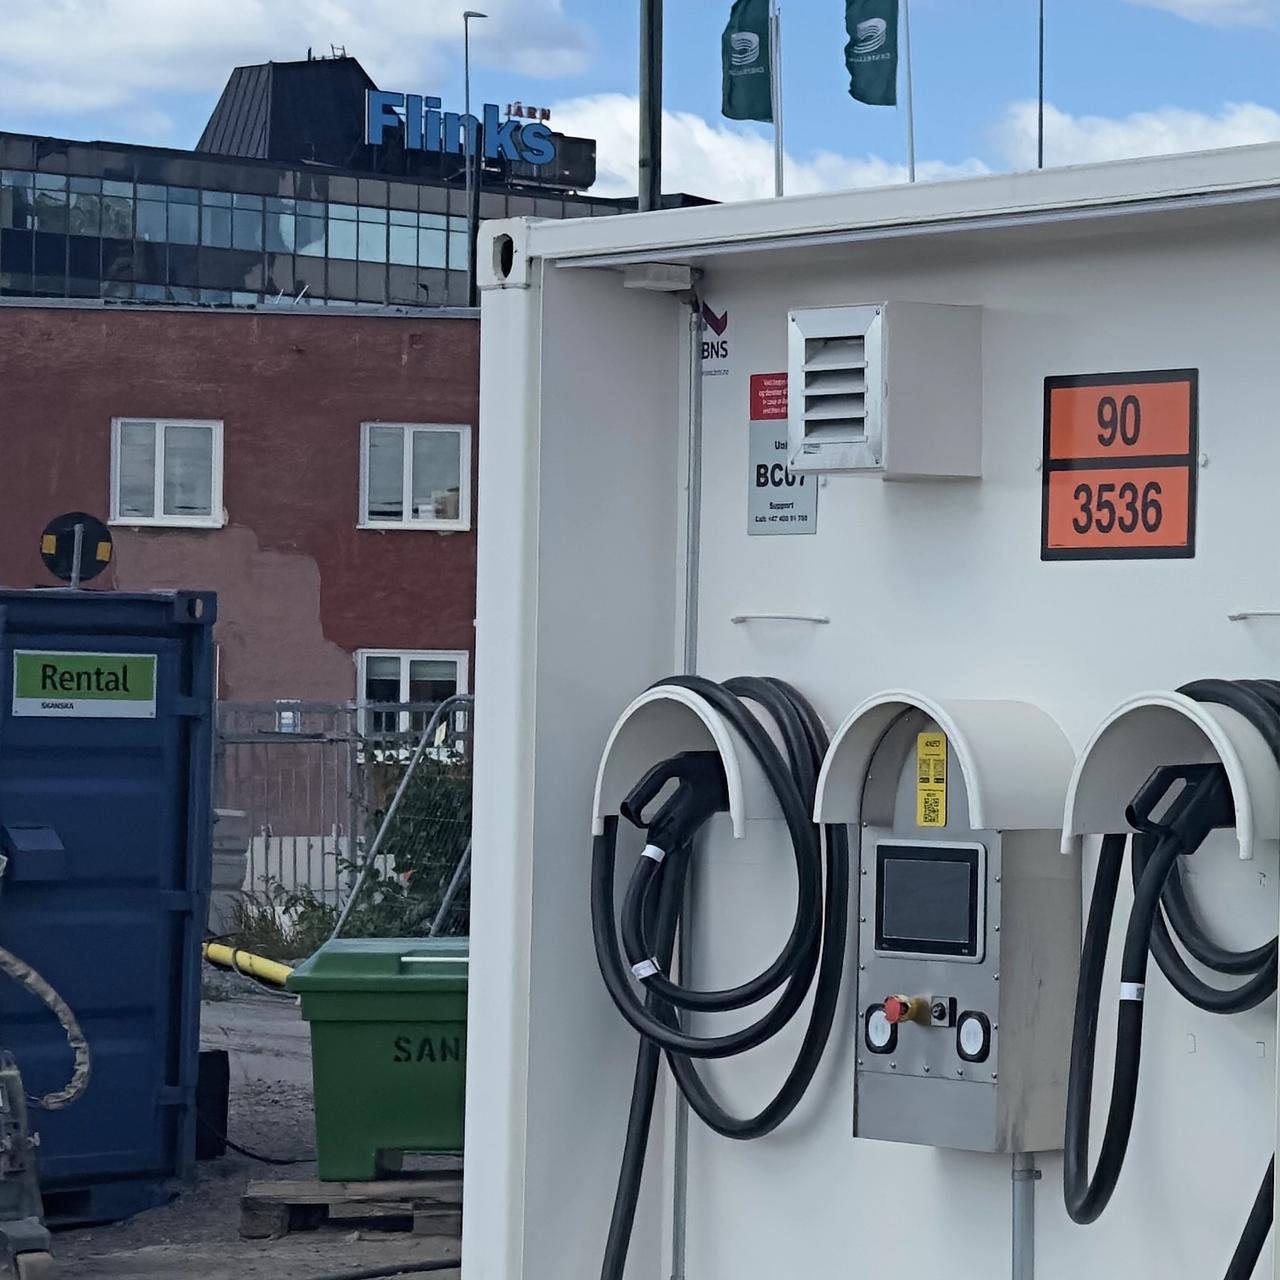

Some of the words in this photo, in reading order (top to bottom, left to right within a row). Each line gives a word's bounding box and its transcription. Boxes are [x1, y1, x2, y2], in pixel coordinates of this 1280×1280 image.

[365, 88, 556, 165] Flinks
[1097, 395, 1141, 447] 90
[1072, 482, 1162, 534] 3536
[41, 664, 130, 692] Rental
